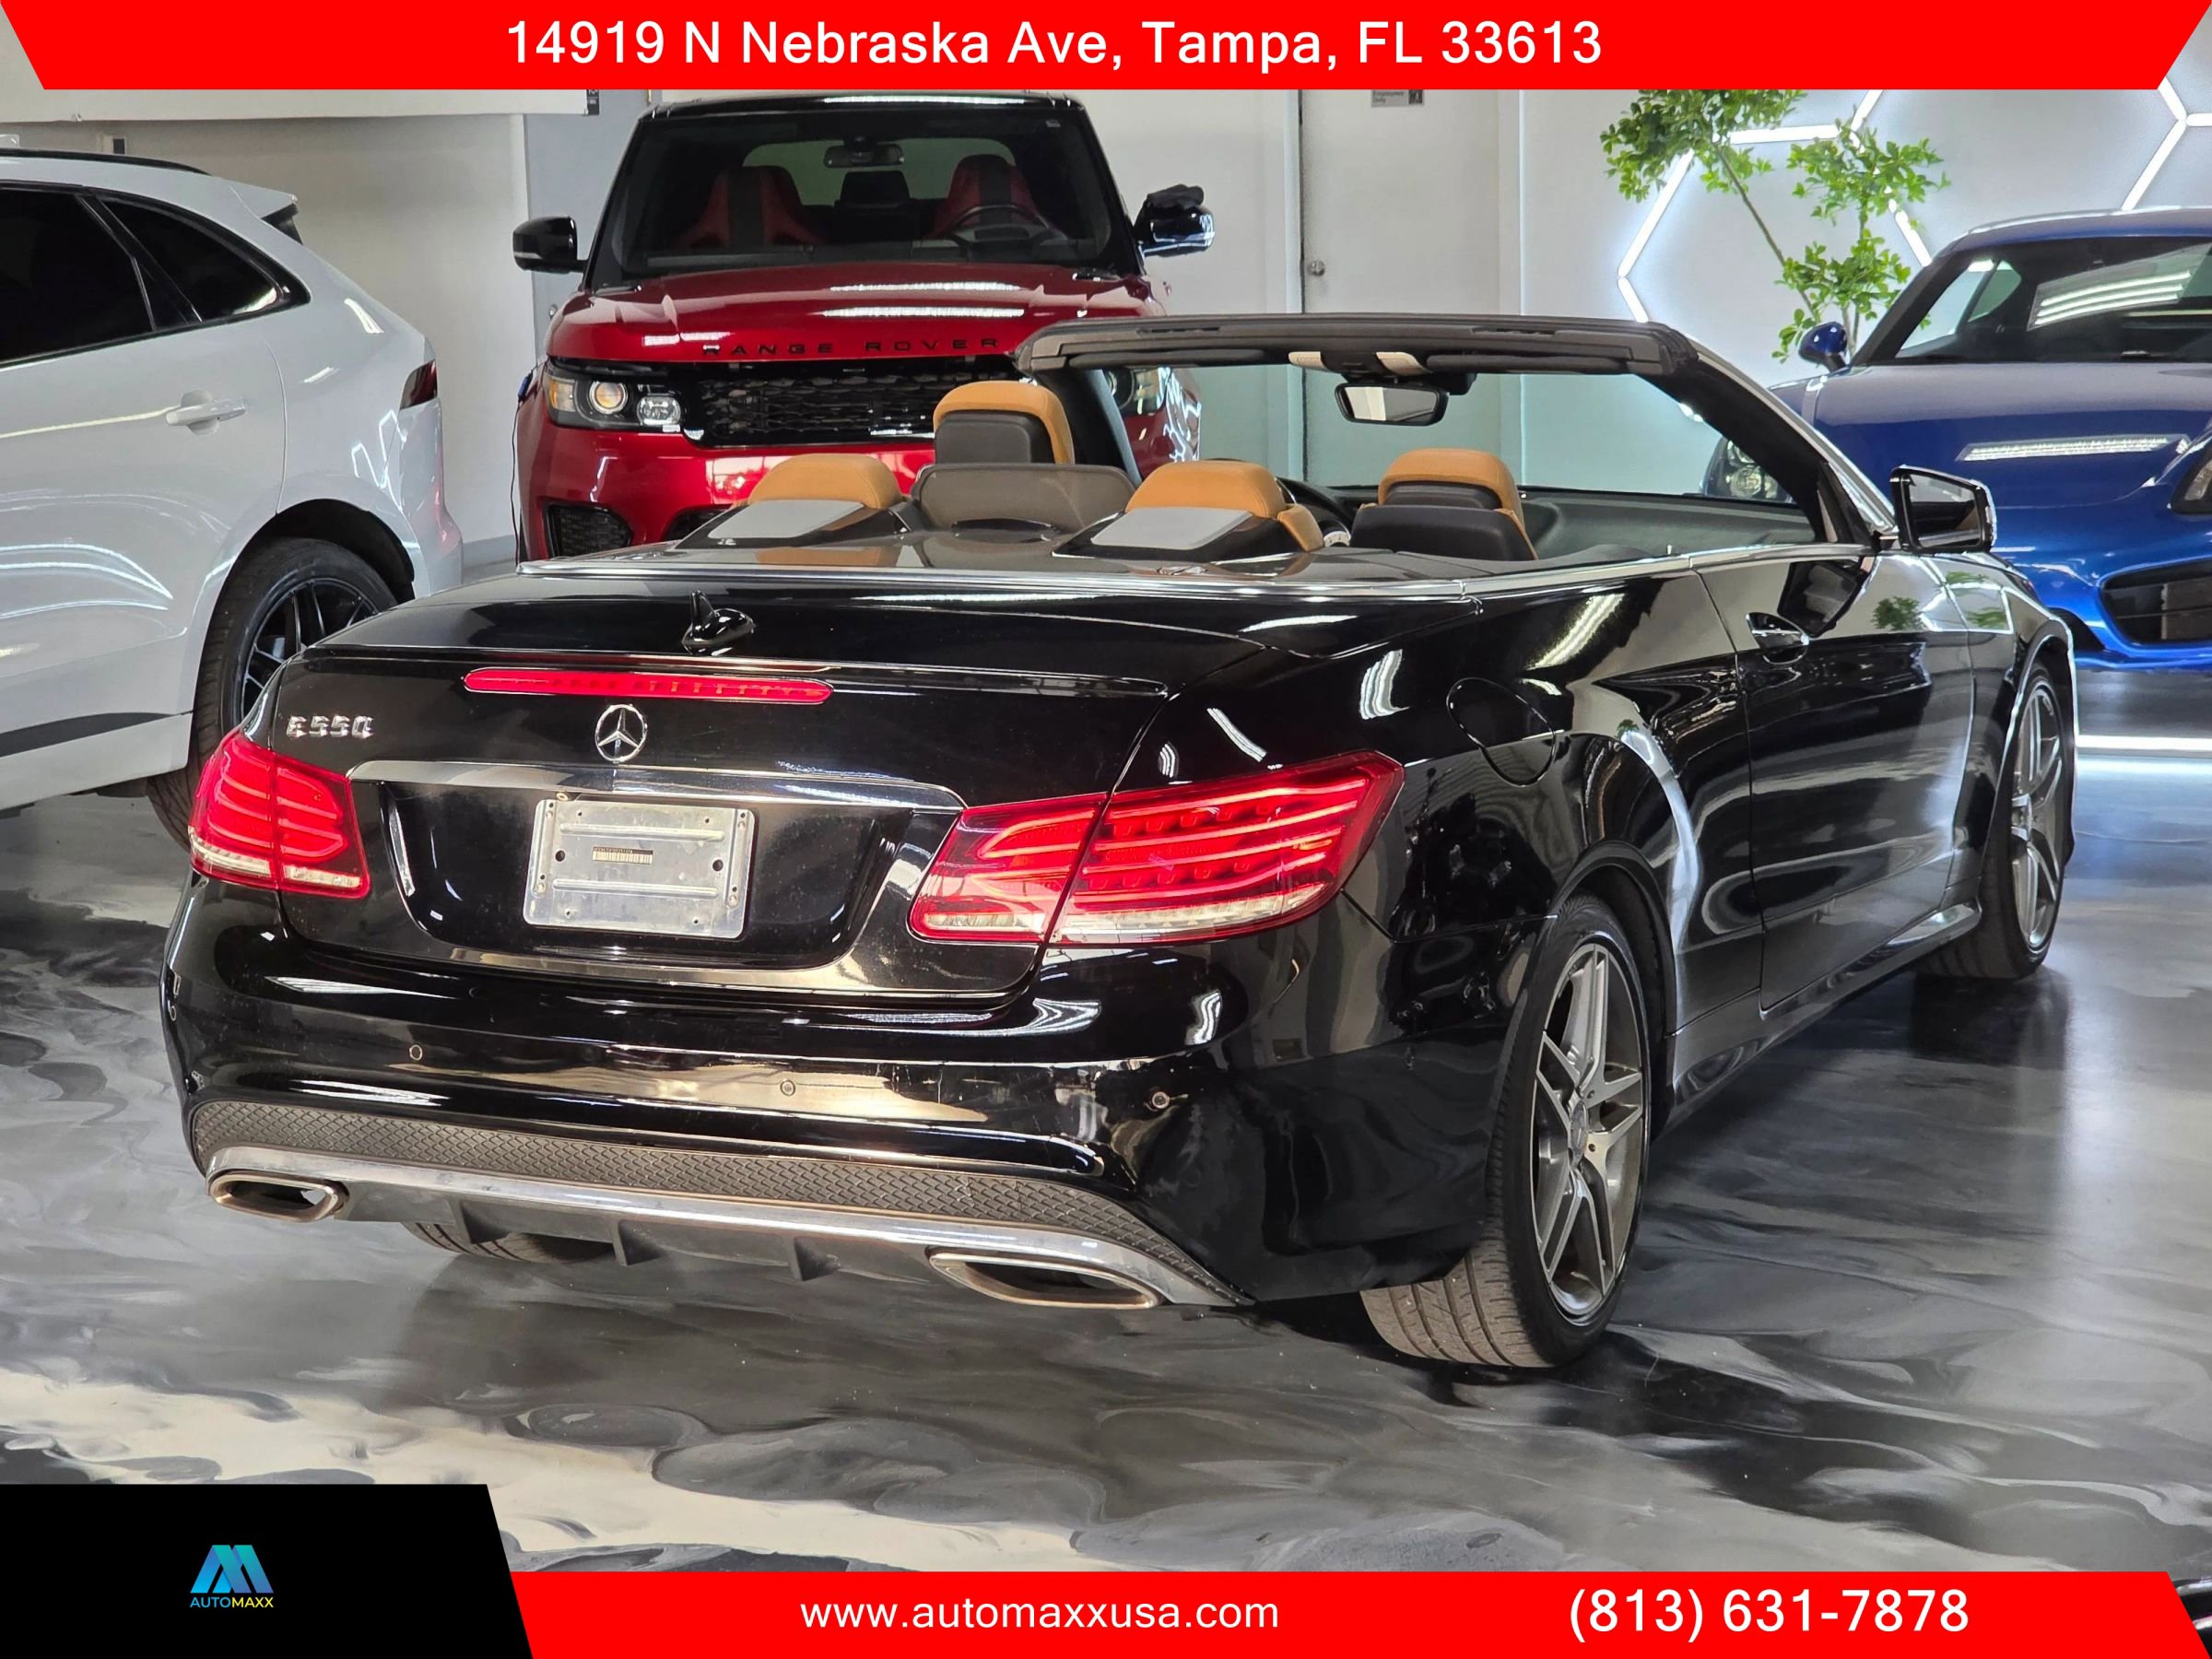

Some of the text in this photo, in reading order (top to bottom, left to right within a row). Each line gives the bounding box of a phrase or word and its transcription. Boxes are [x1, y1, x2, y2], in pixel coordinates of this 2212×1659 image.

[702, 338, 999, 356] RANGE ROVER
[286, 714, 374, 738] E550
